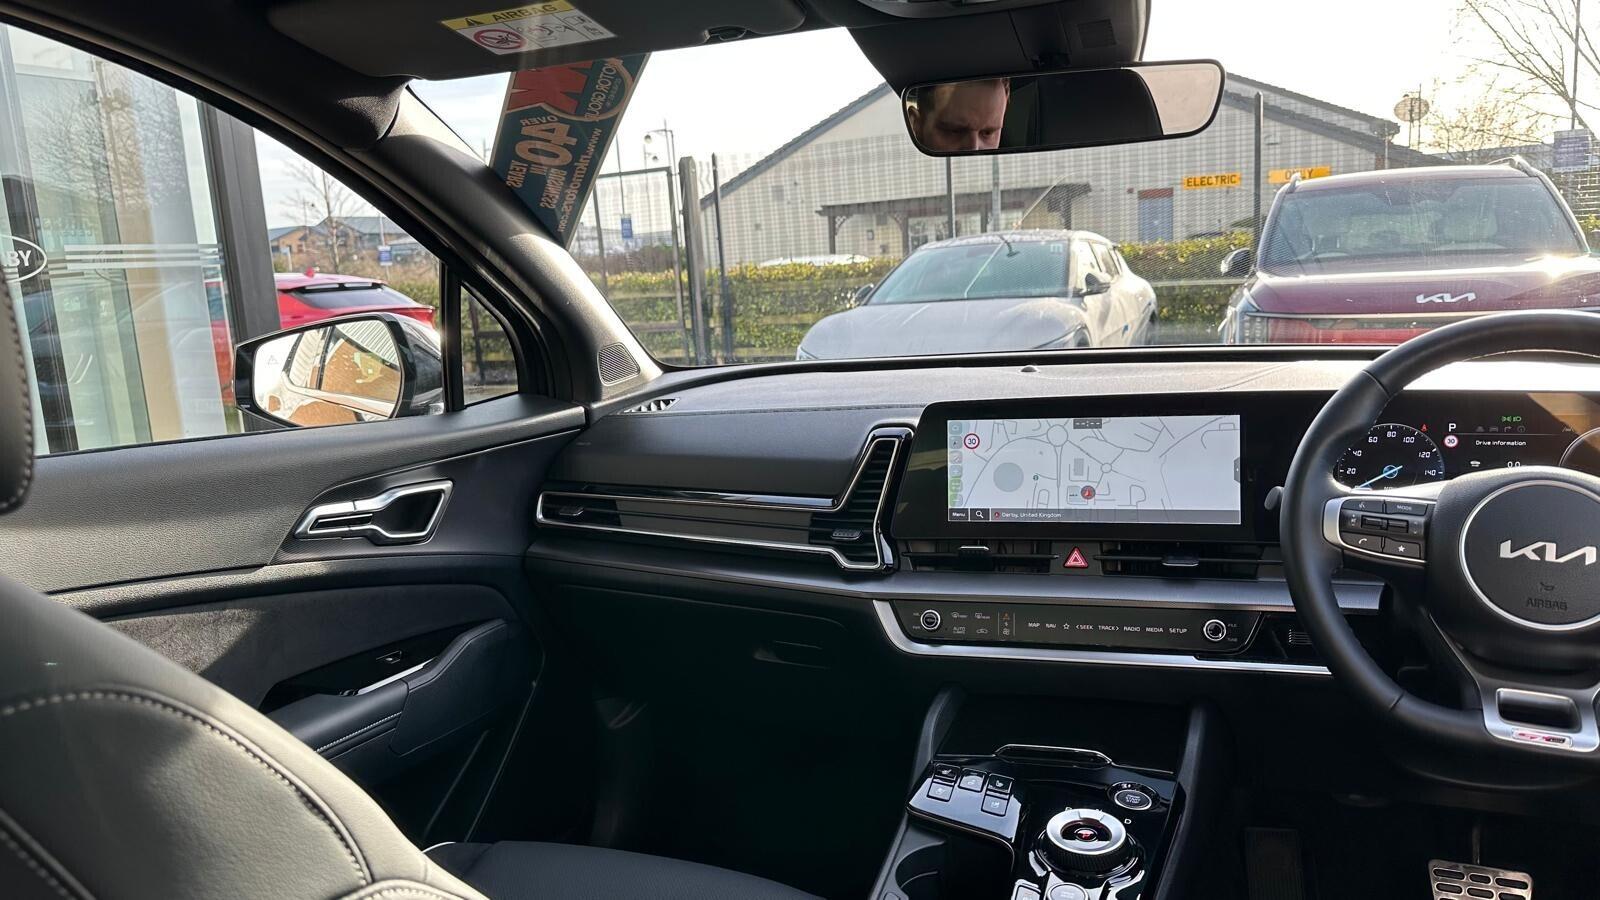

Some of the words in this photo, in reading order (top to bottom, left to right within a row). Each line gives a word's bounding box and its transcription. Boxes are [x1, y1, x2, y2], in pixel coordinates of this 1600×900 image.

[492, 4, 557, 21] AIRBAG
[1186, 174, 1237, 187] ELECTRIC
[1448, 423, 1457, 432] P
[1346, 467, 1356, 475] 20
[1039, 511, 1062, 519] Kingdom
[1500, 540, 1596, 566] KIA
[1526, 597, 1567, 611] AIRBAG
